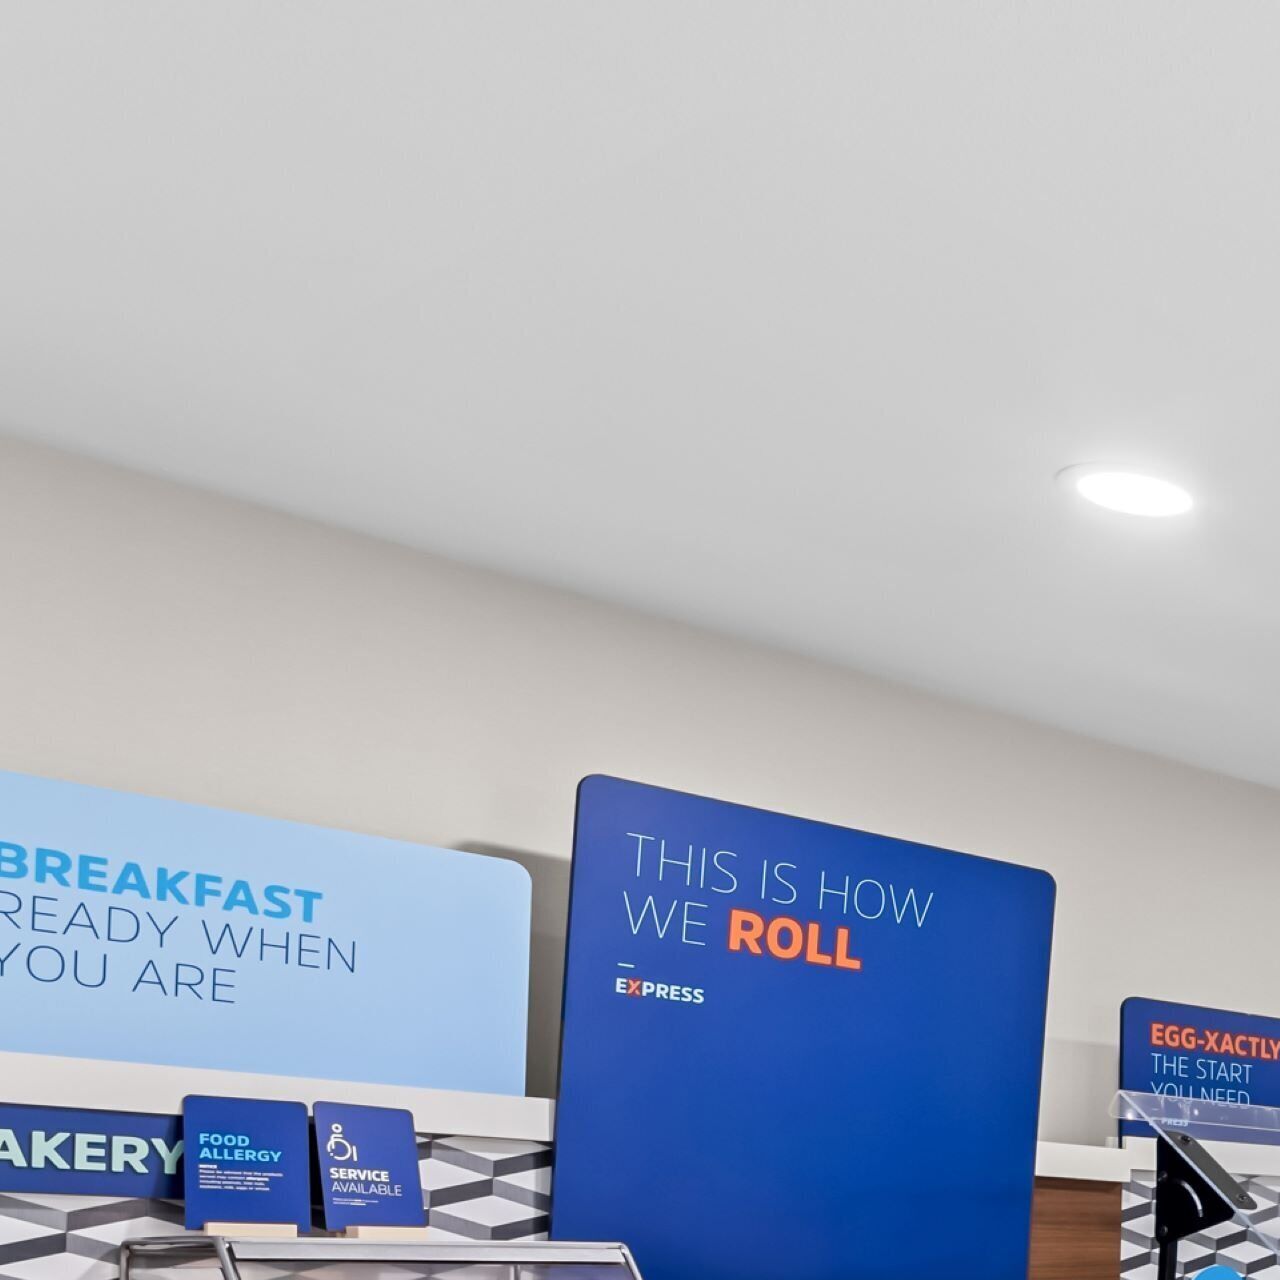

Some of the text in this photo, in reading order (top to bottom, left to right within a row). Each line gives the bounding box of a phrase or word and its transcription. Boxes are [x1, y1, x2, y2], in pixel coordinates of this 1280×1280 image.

[0, 840, 323, 924] BREAKFAST
[626, 832, 934, 928] THIS IS HOW
[0, 889, 356, 973] READY WHEN
[623, 890, 862, 971] WE ROLL
[0, 942, 236, 1003] YOU ARE
[615, 977, 705, 1005] EXPRESS
[1151, 1052, 1253, 1084] THE START
[1151, 1080, 1251, 1109] YOU NEED
[0, 1129, 184, 1174] AKERY
[199, 1132, 250, 1147] FOOD
[199, 1147, 282, 1162] ALLERGY
[329, 1167, 390, 1182] SERVICE
[331, 1181, 403, 1197] AVAILABLE
